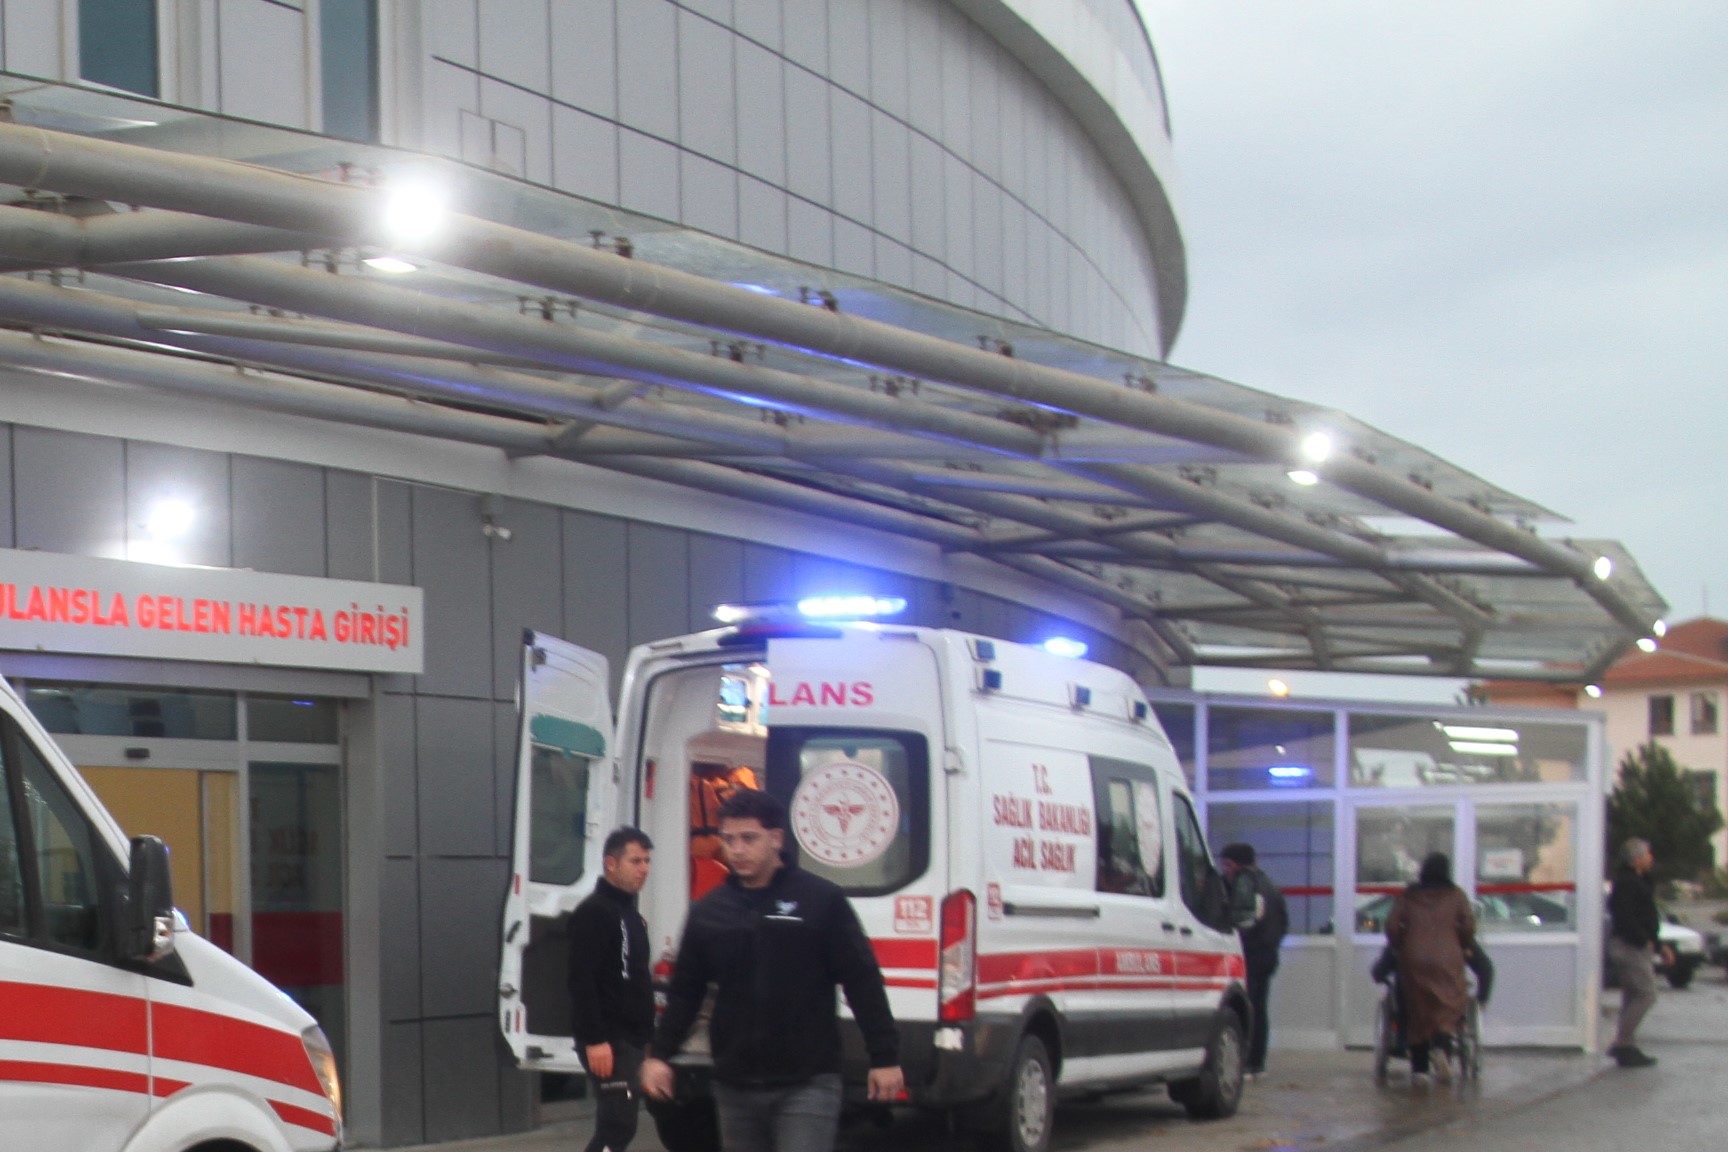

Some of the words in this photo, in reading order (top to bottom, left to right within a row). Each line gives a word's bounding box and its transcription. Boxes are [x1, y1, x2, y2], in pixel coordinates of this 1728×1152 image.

[136, 594, 230, 635] GELEN
[238, 602, 328, 642] HASTA
[334, 602, 409, 650] GİRİŞİ
[768, 682, 874, 706] LANS
